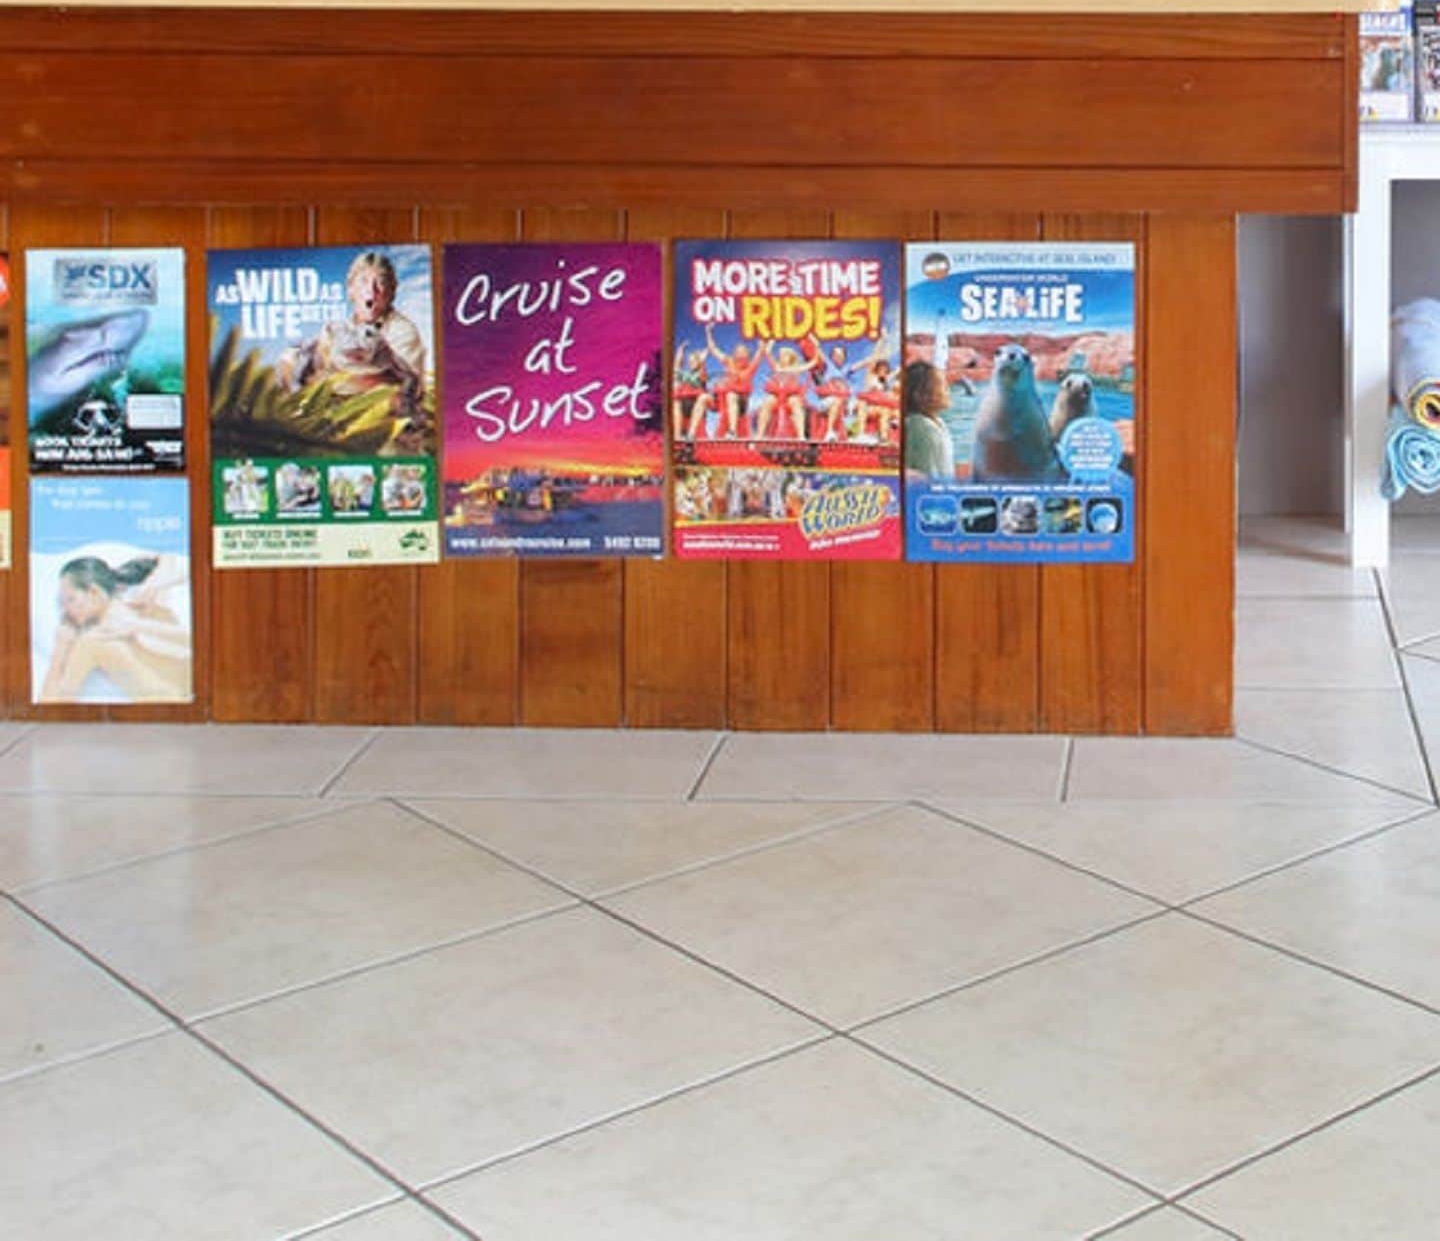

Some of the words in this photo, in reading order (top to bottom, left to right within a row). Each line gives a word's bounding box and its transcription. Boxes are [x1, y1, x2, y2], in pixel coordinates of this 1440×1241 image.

[88, 264, 151, 290] SDX
[215, 284, 239, 303] AS
[235, 268, 319, 303] WILD
[320, 282, 344, 301] AS
[455, 260, 626, 325] Cruise
[693, 260, 788, 296] MORE
[797, 261, 881, 296] TIME
[241, 304, 303, 339] LIFE
[694, 297, 735, 322] ON
[741, 296, 882, 339] RIDES!
[961, 283, 1018, 322] SEA
[524, 316, 577, 373] at
[465, 362, 653, 442] Sunset
